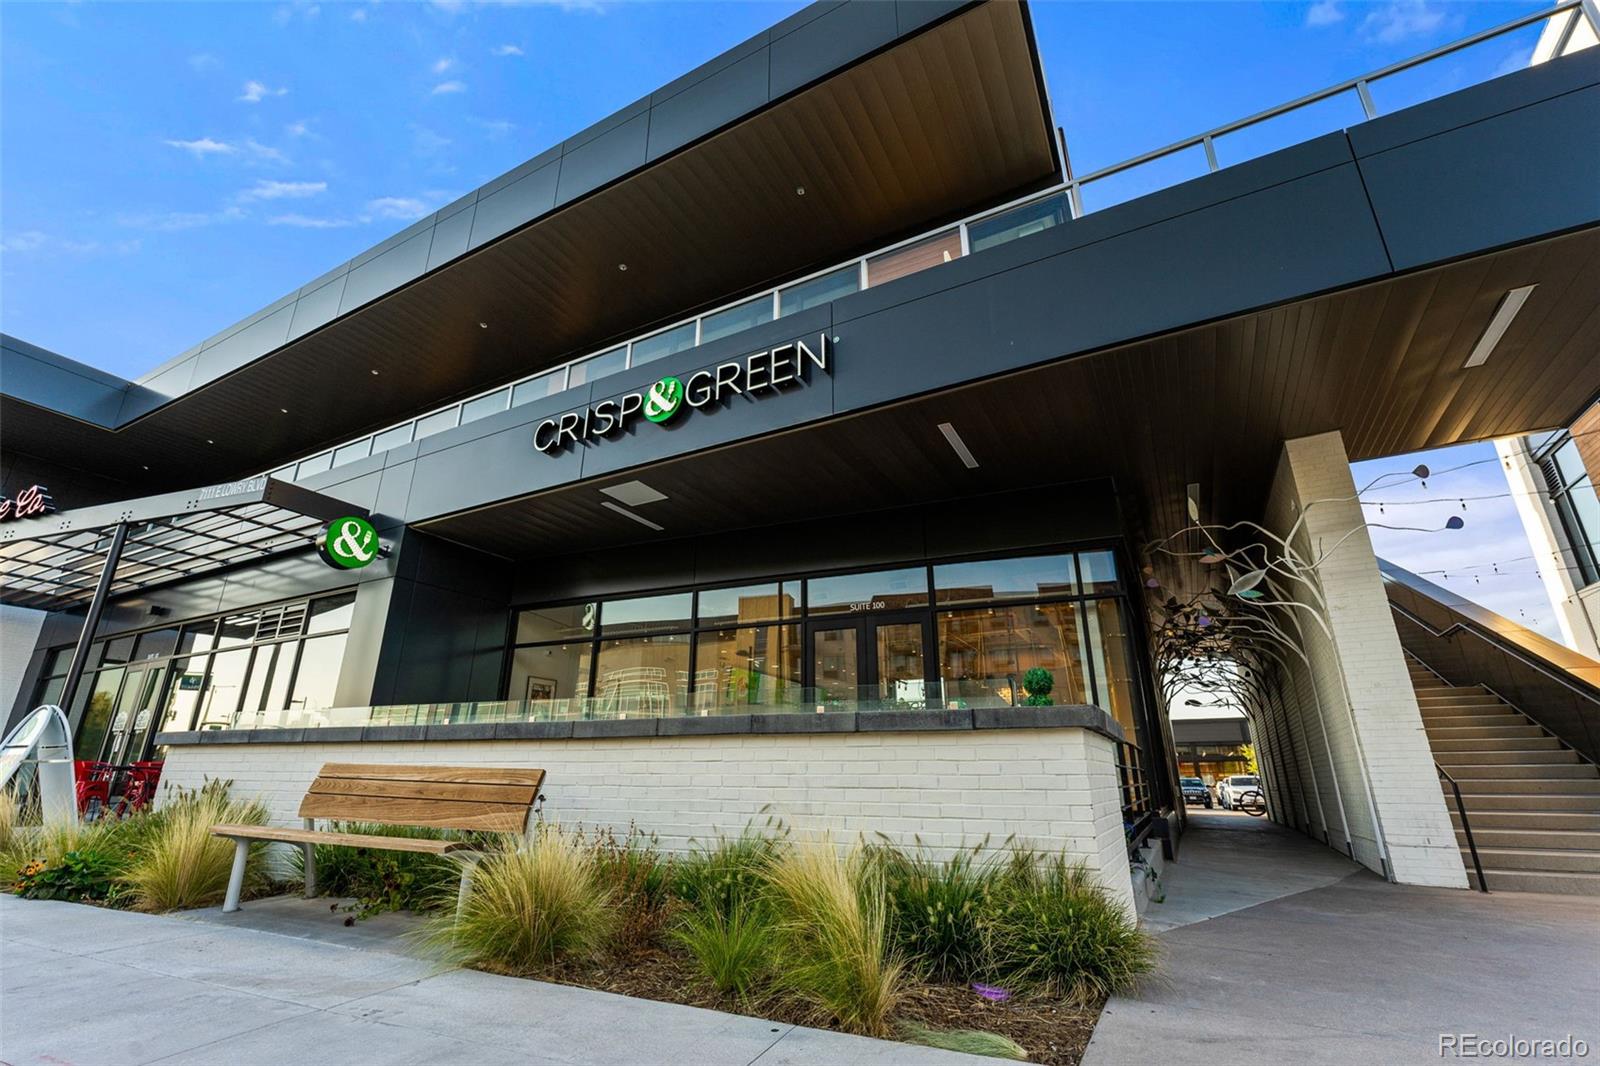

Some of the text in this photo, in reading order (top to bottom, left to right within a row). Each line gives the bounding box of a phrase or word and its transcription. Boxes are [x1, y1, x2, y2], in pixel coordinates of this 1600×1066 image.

[15, 484, 45, 518] Co.
[850, 601, 886, 611] SUITE 100
